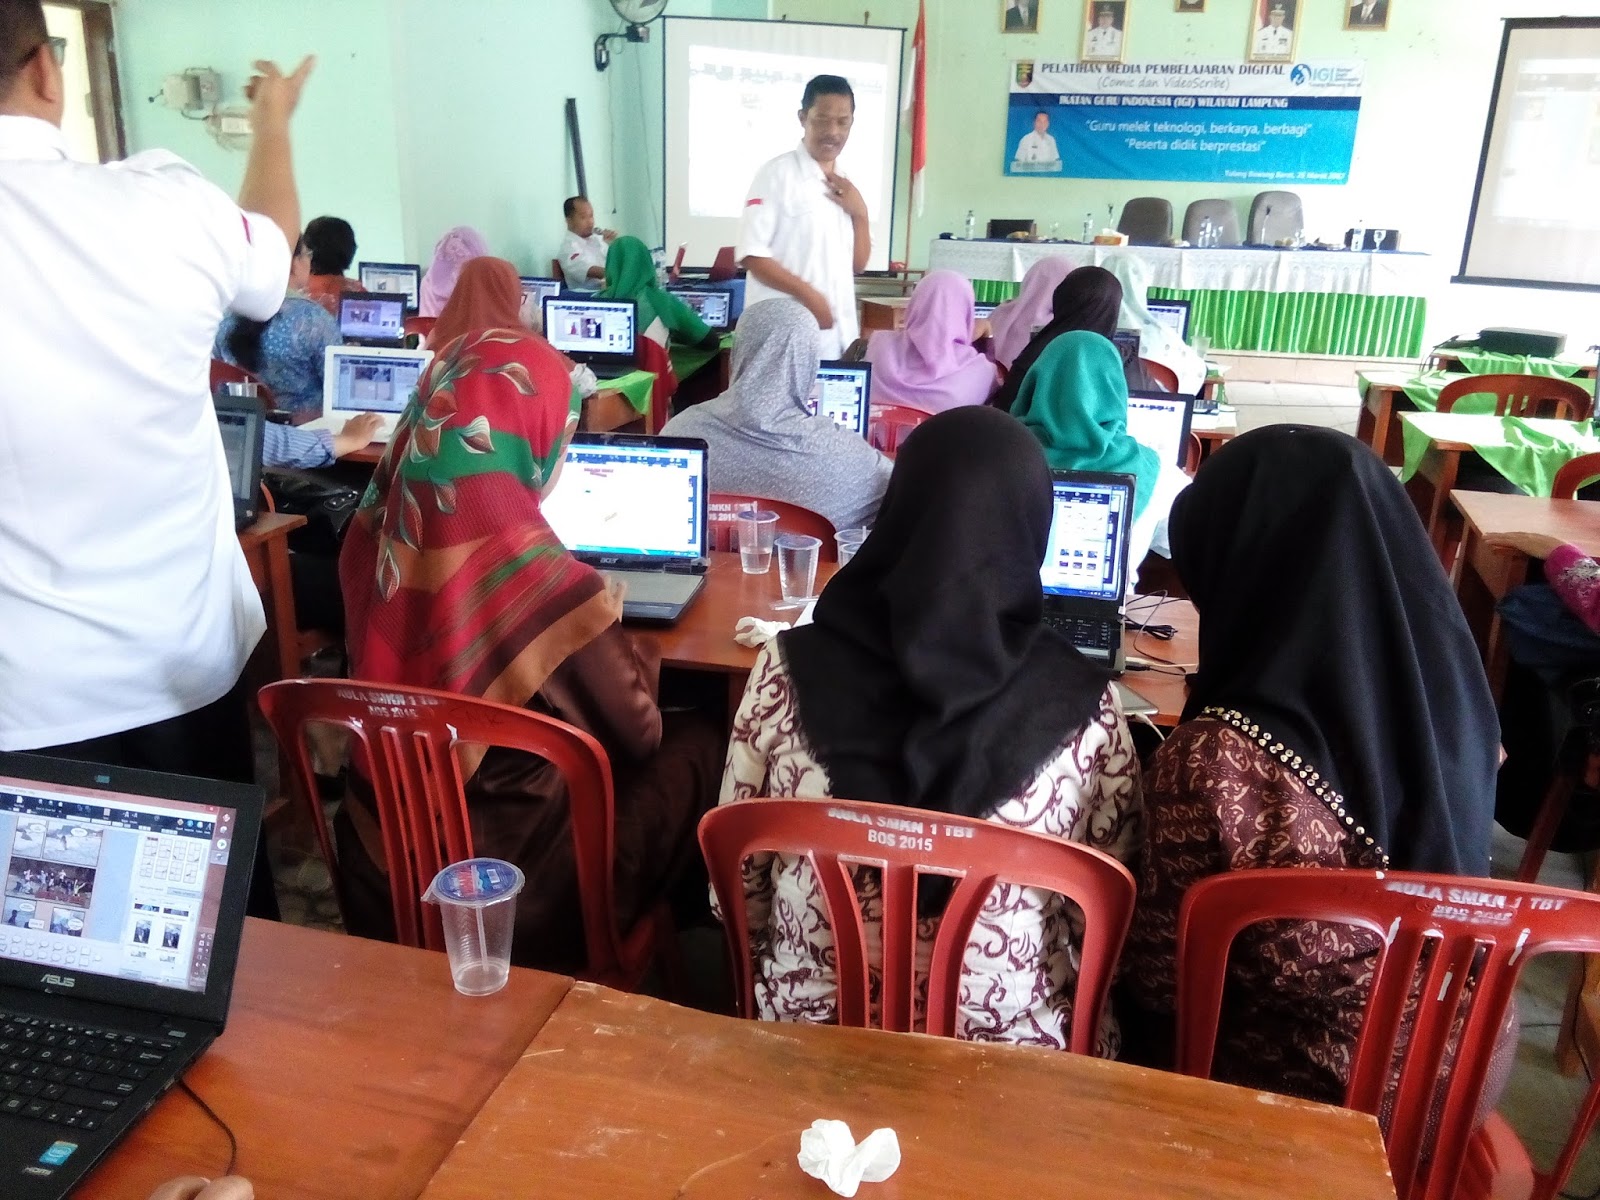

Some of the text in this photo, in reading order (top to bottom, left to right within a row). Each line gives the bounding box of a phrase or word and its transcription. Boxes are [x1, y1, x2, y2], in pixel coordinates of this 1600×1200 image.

[1041, 63, 1285, 76] PELATIHAN MEDIA PEMBELAJARAN DIGITAL
[1312, 67, 1335, 82] IGI
[1097, 75, 1231, 90] (Comic dan VideoScribe)
[1059, 94, 1289, 108] IKATAN GURU INDONESIA (IGI) WILAYAH LAMPUNG
[1118, 121, 1151, 133] melek
[1153, 121, 1206, 136] teknologi,
[1209, 122, 1260, 137] berkarya,
[1170, 138, 1197, 151] didik
[877, 815, 924, 834] SMKN
[930, 823, 938, 835] 1
[942, 825, 976, 839] TBT
[867, 828, 934, 852] BOS 2015
[1447, 887, 1506, 909] SMKN
[1529, 895, 1568, 912] TBT
[40, 973, 76, 988] ASUS
